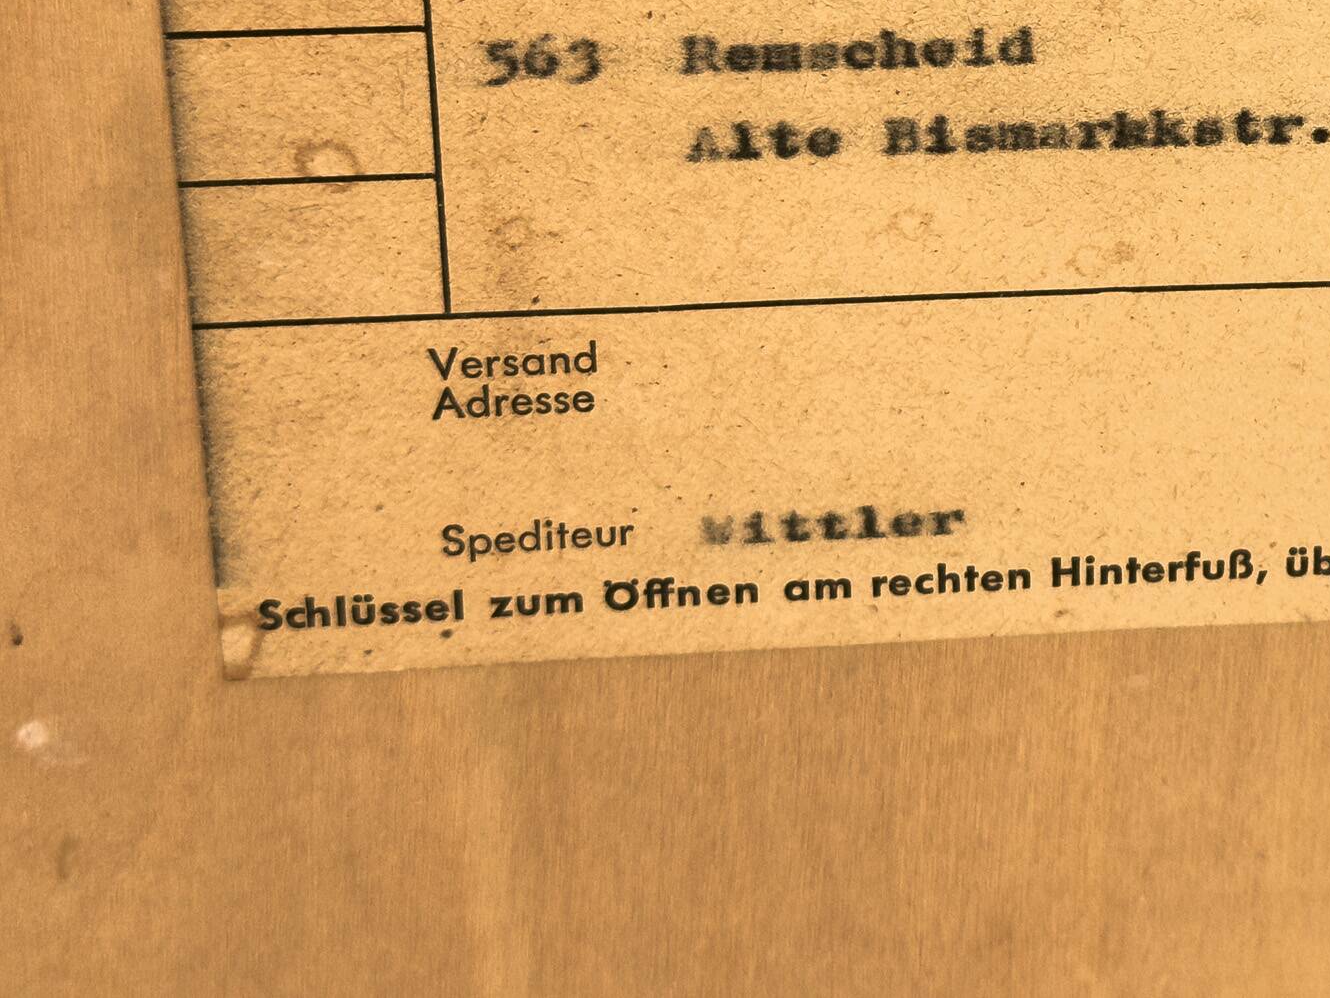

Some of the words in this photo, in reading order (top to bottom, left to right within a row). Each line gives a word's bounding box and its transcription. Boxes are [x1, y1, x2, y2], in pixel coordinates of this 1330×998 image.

[484, 32, 604, 86] 563
[680, 24, 1036, 76] Remscheid
[684, 118, 842, 164] Alte
[426, 340, 600, 382] Versand
[430, 386, 598, 422] Adresse
[440, 518, 636, 564] Spediteur
[256, 588, 466, 634] Schlüssel
[488, 590, 586, 622] zum
[602, 576, 762, 614] Öffnen
[782, 576, 854, 604] am
[870, 558, 1034, 600] rechten
[1050, 548, 1268, 592] Hinterfuß,
